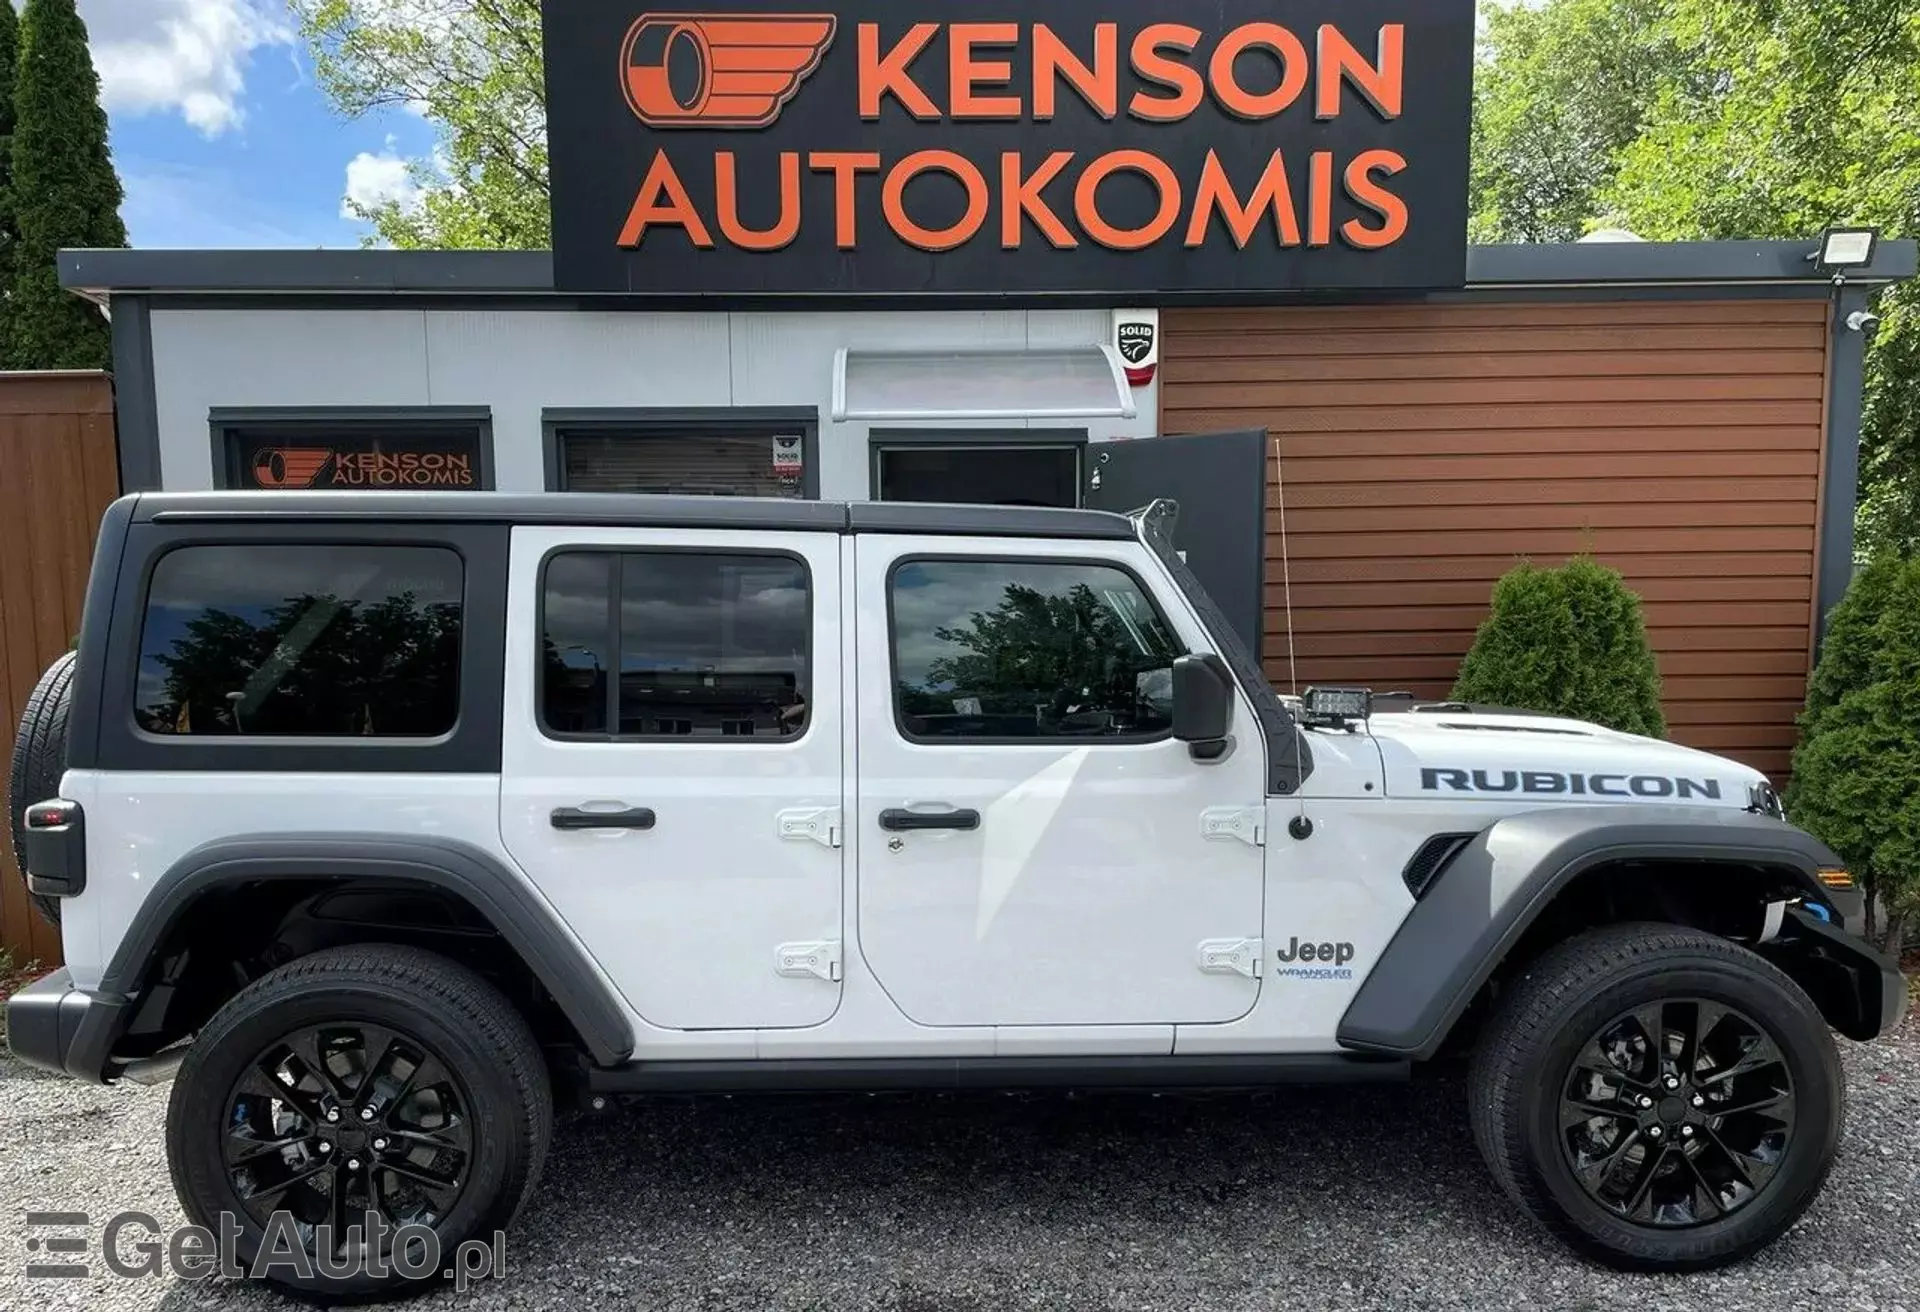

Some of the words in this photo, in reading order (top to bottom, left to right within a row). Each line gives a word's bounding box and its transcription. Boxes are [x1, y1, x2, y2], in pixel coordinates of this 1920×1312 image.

[857, 22, 1405, 121] KENSON
[616, 147, 1410, 252] AUTOKOMIS
[1120, 326, 1152, 336] SOLID
[336, 452, 468, 469] KENSON
[331, 467, 473, 485] AUTOKOMIS
[1420, 767, 1722, 800] RUBICON
[1277, 936, 1355, 966] Jeep
